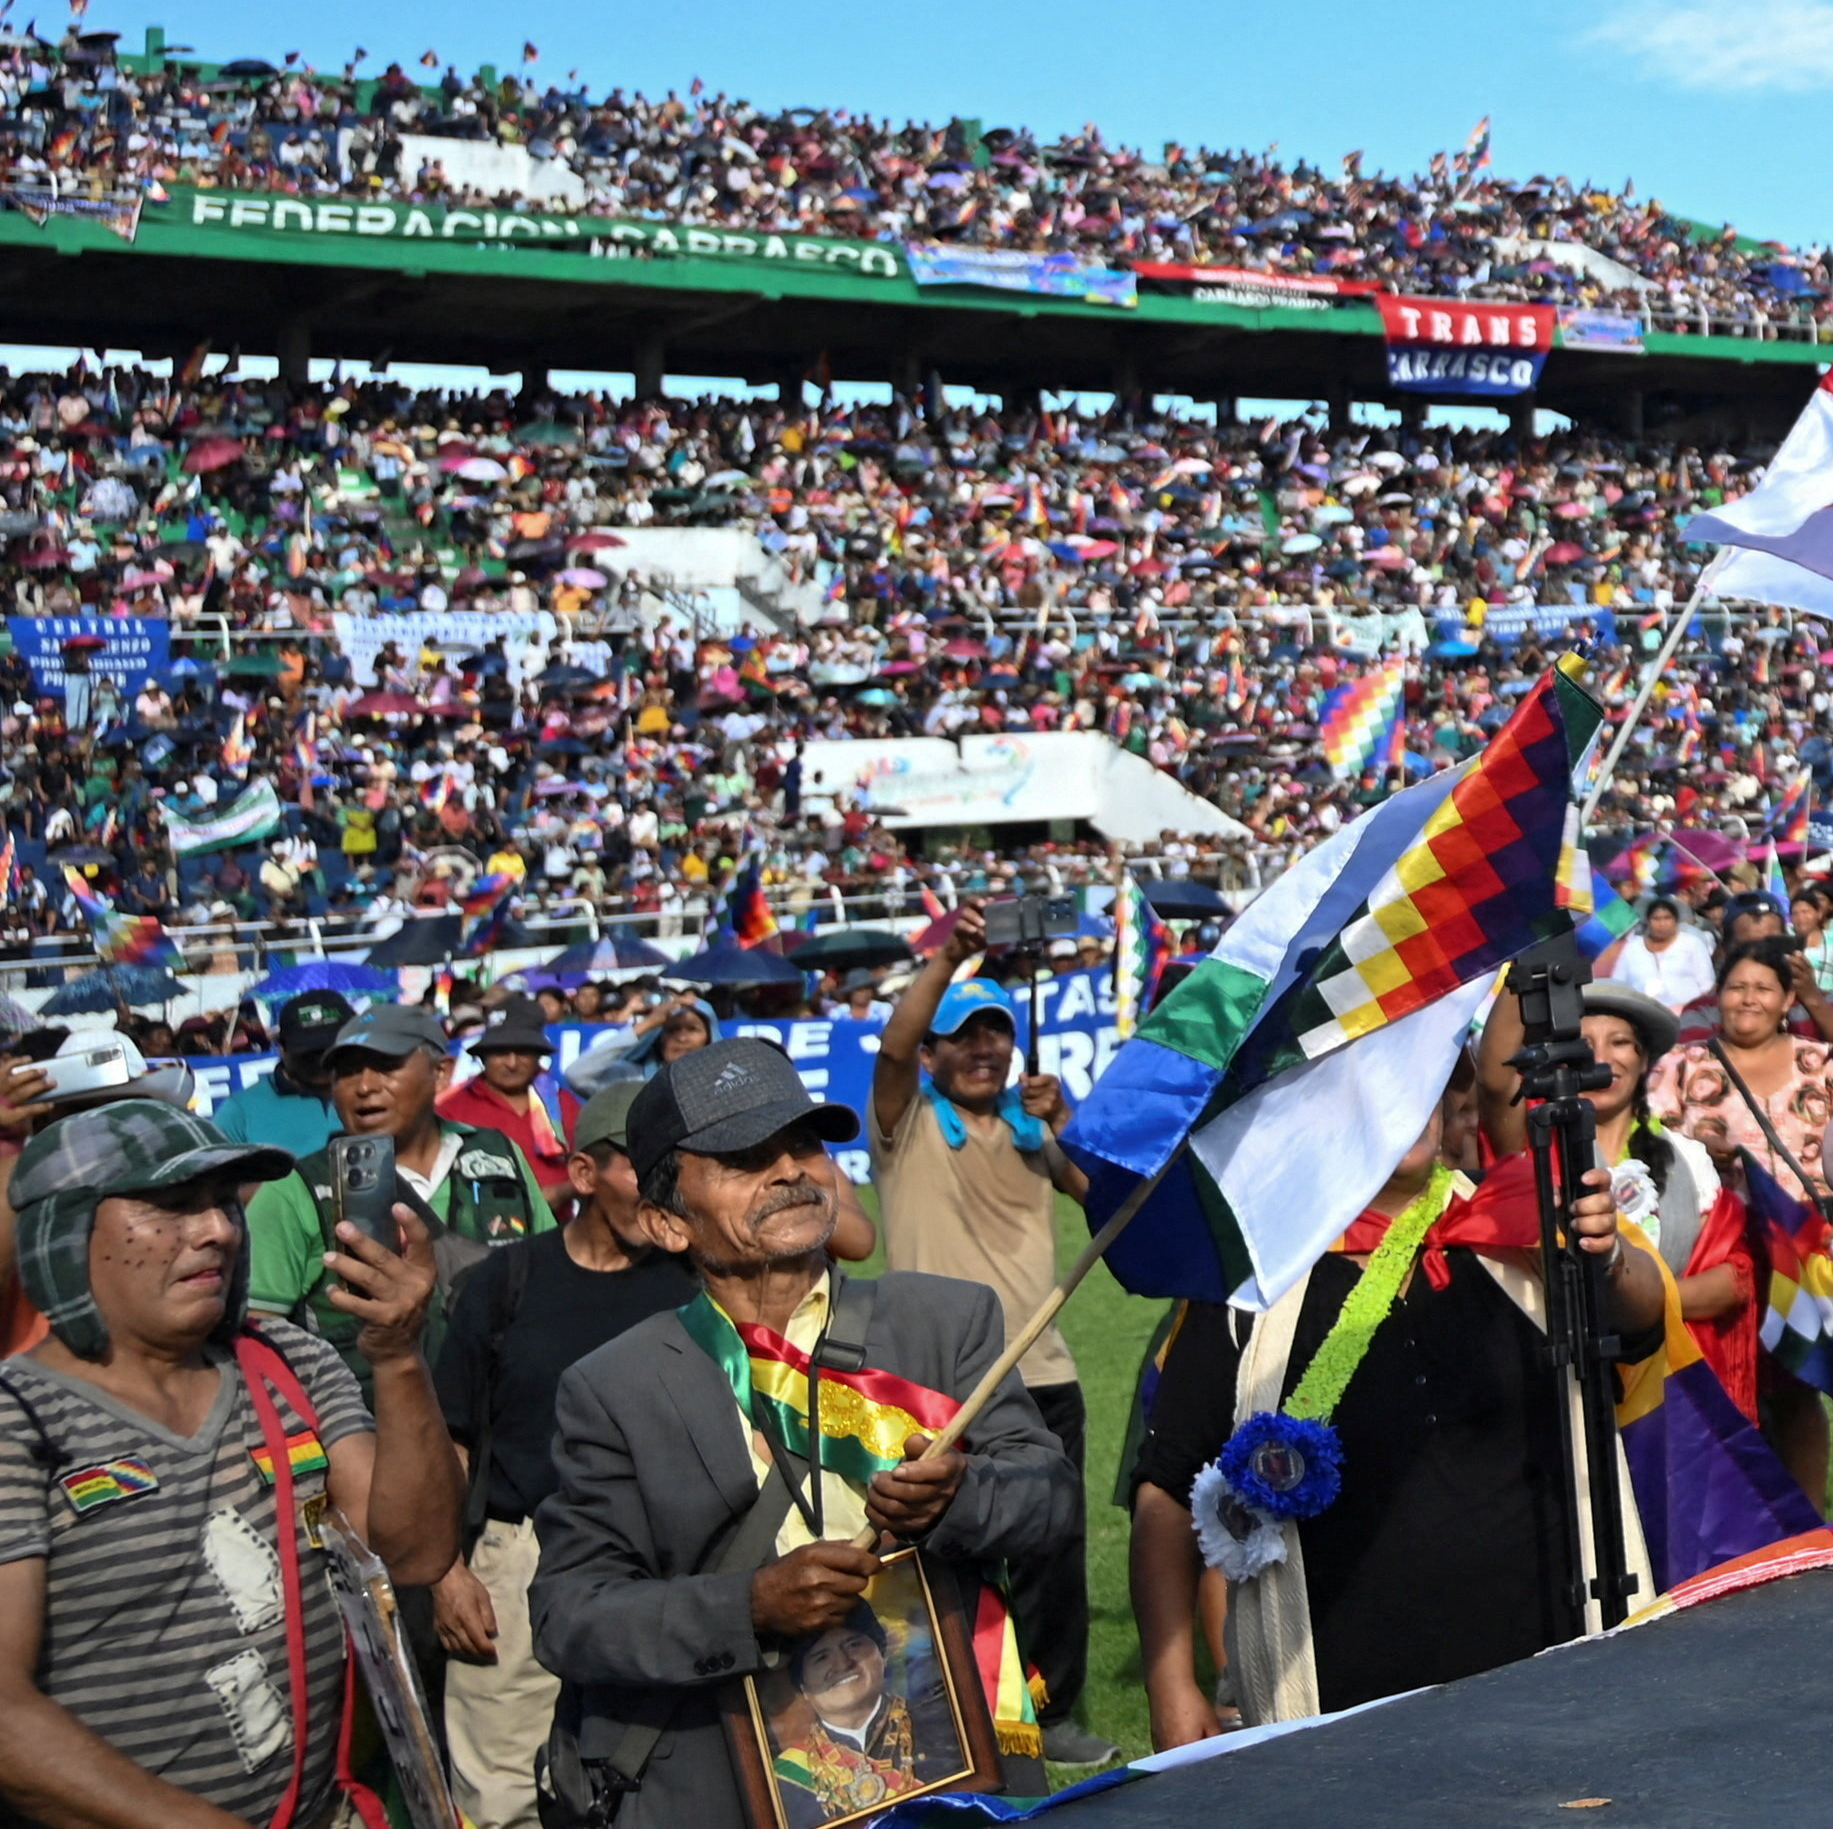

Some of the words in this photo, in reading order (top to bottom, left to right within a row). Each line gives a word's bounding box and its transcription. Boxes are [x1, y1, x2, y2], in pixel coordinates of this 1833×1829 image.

[1400, 306, 1538, 347] TRANS
[1390, 351, 1534, 388] CARRASCO
[35, 618, 146, 635] CENTRAL
[713, 1074, 760, 1096] adidas
